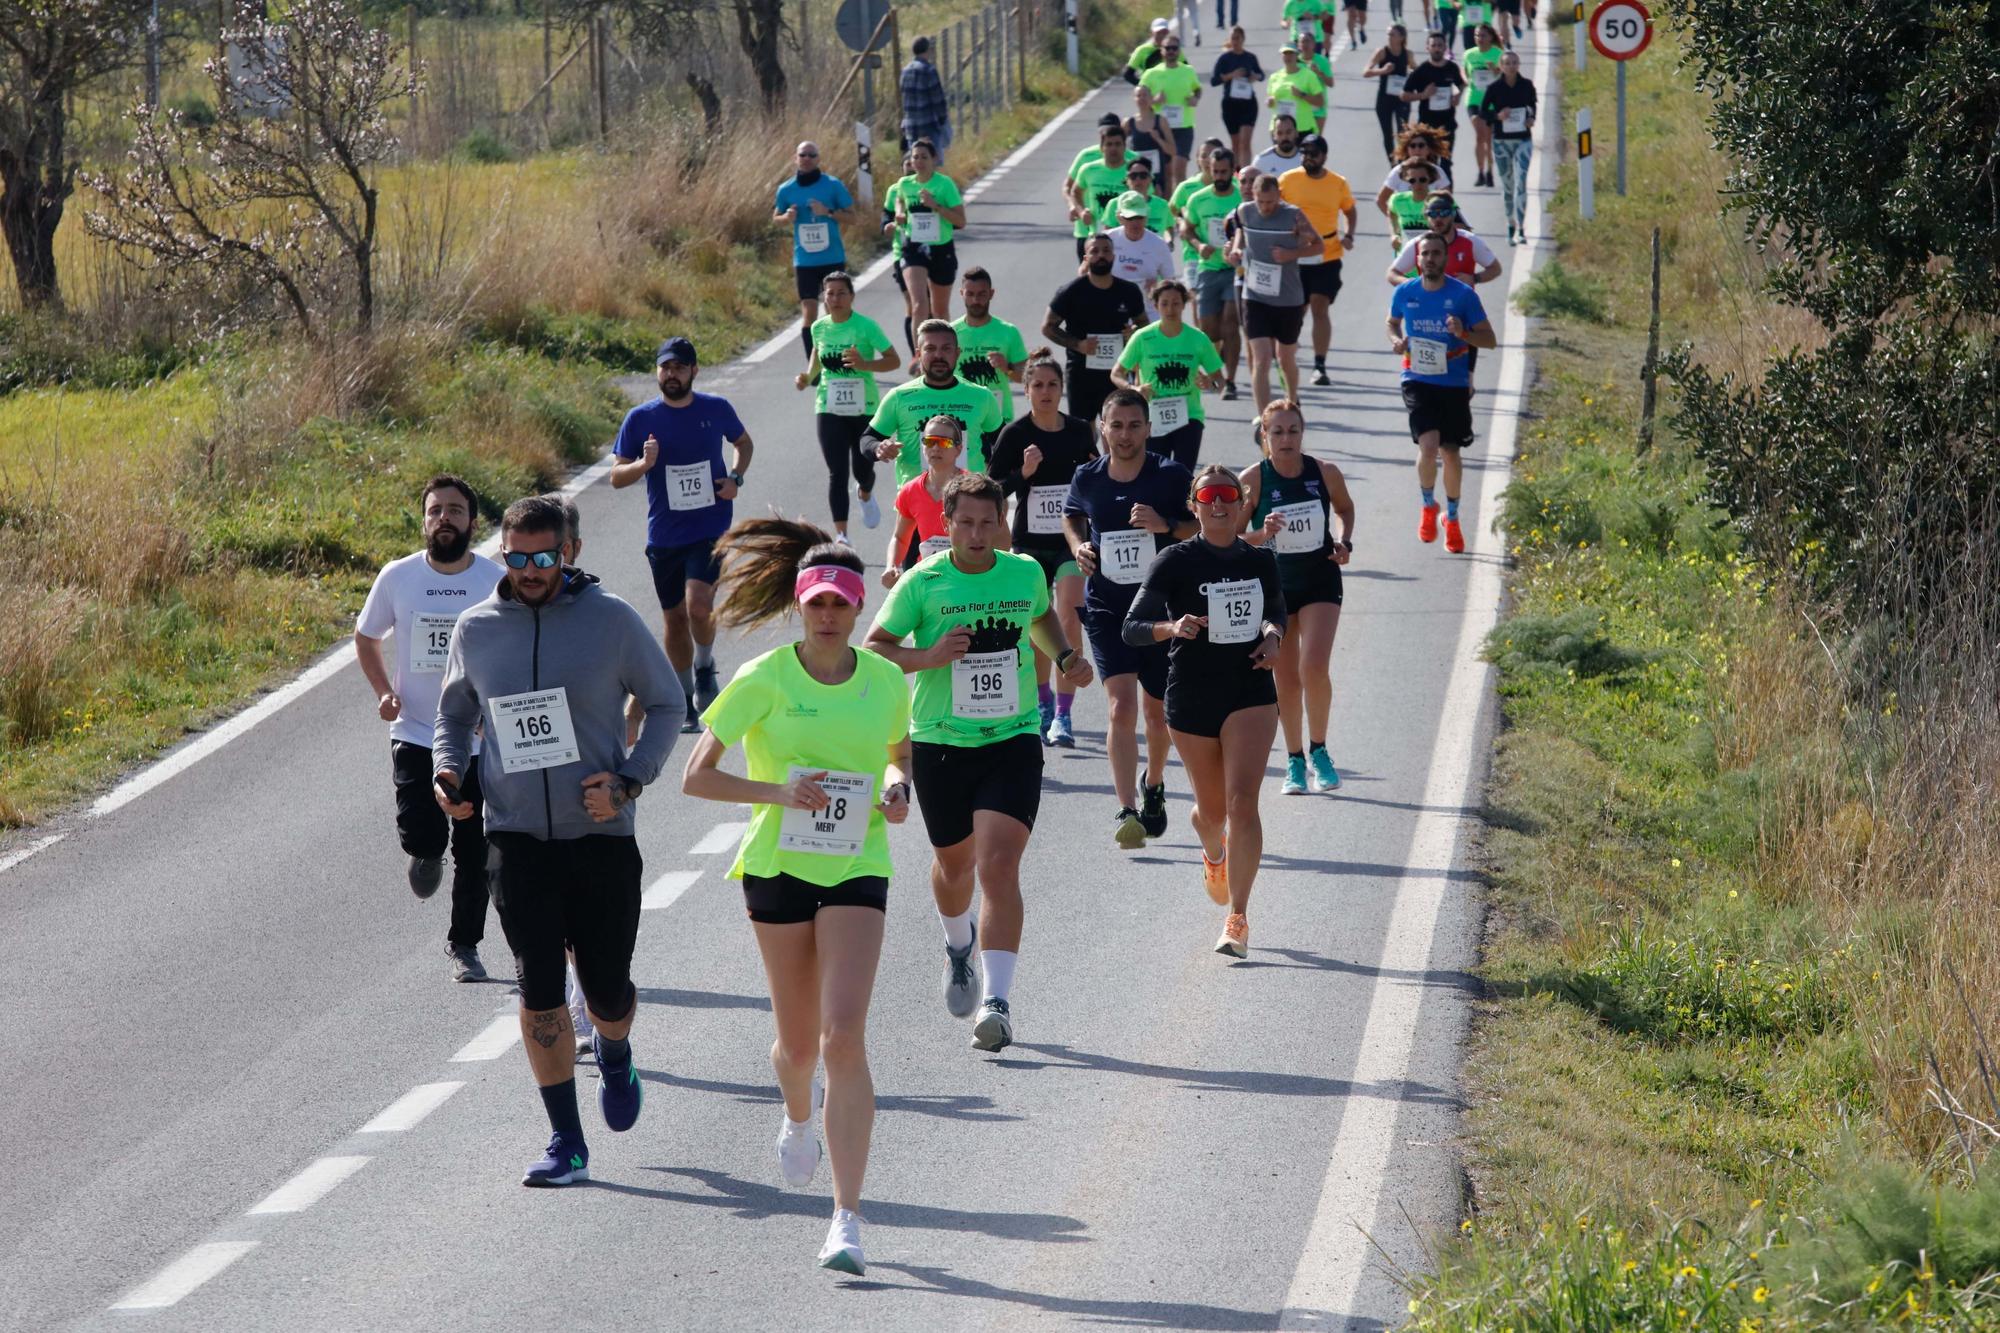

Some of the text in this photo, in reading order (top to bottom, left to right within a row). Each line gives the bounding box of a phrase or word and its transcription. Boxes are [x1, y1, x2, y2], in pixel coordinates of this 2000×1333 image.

[1605, 18, 1638, 39] 50
[1419, 349, 1436, 361] 156
[836, 390, 854, 401] 211
[1159, 408, 1178, 420] 163
[679, 477, 702, 491] 176
[1040, 500, 1063, 514] 105
[1288, 518, 1311, 534] 401
[1114, 546, 1140, 563] 117
[941, 604, 966, 615] Cursa
[969, 602, 986, 612] Flor
[999, 599, 1032, 610] Ametller
[1225, 600, 1252, 619] 152
[428, 631, 452, 648] 15
[427, 648, 443, 656] Carlos
[970, 672, 1003, 692] 196
[970, 693, 987, 701] Miguel
[515, 714, 552, 739] 166
[514, 736, 560, 750] Fermin Fernandez
[814, 821, 836, 833] MERY
